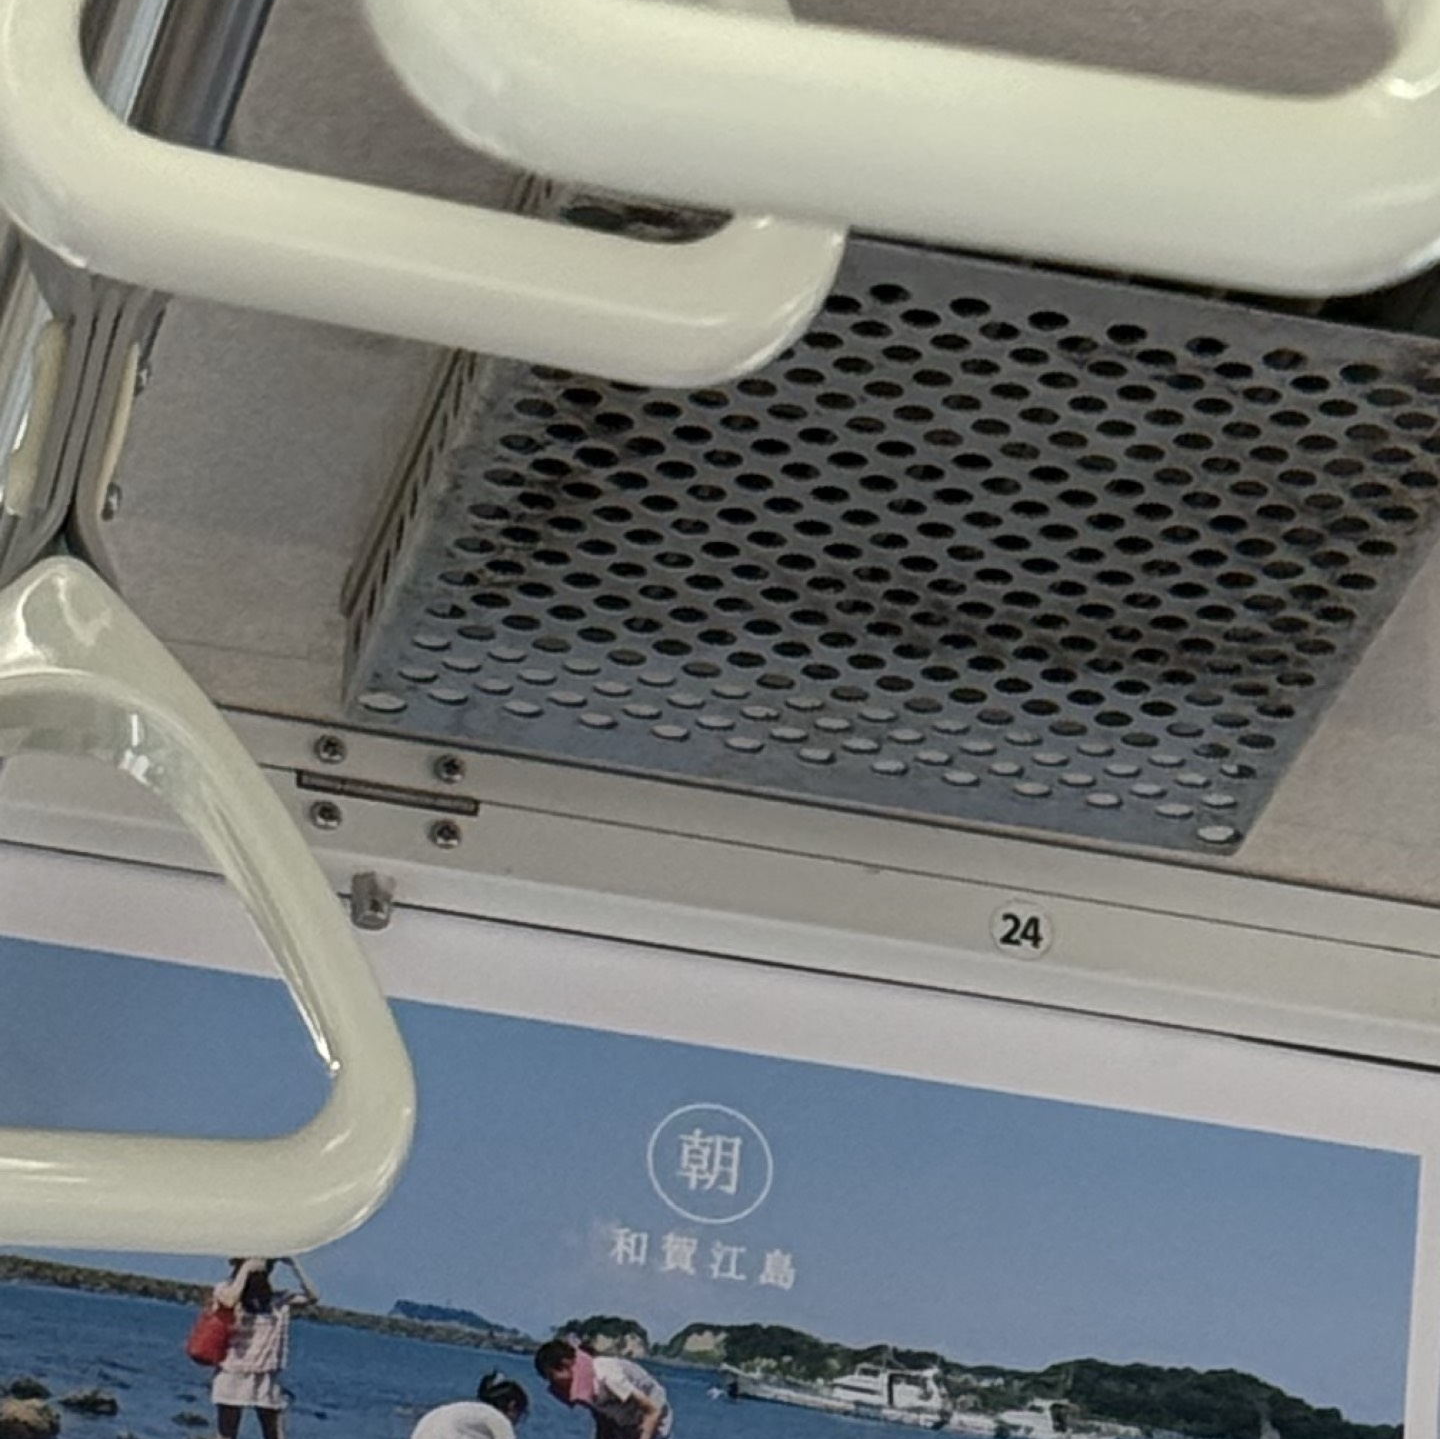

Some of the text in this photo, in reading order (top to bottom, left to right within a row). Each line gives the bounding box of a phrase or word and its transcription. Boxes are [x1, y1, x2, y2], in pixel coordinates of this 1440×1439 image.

[1000, 912, 1044, 950] 24
[676, 1128, 742, 1195] 朝
[609, 1227, 796, 1291] 和賀江島
